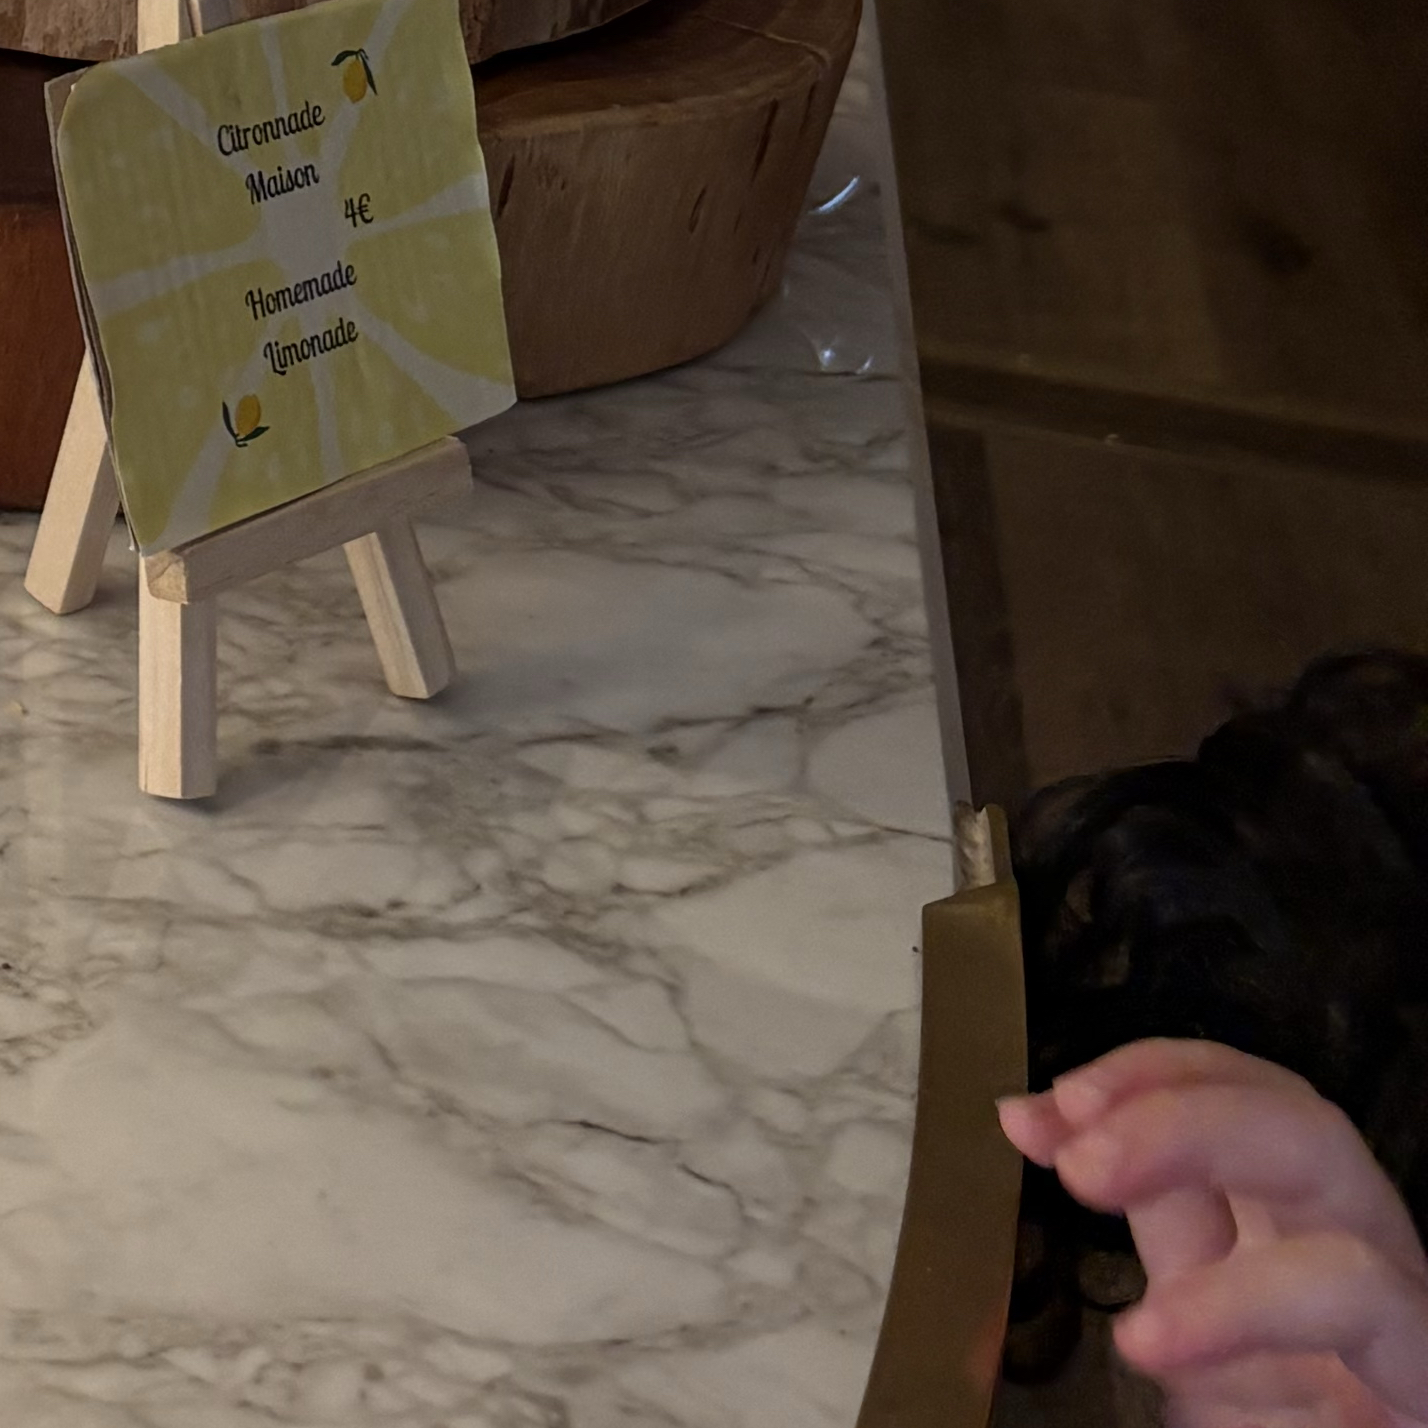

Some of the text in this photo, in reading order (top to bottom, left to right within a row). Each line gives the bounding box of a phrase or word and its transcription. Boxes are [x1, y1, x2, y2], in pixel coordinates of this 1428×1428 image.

[217, 99, 326, 156] Citronnade
[244, 163, 320, 205] Maison
[344, 192, 374, 228] 4€
[244, 259, 357, 321] Homemade
[263, 316, 359, 376] Limonade
